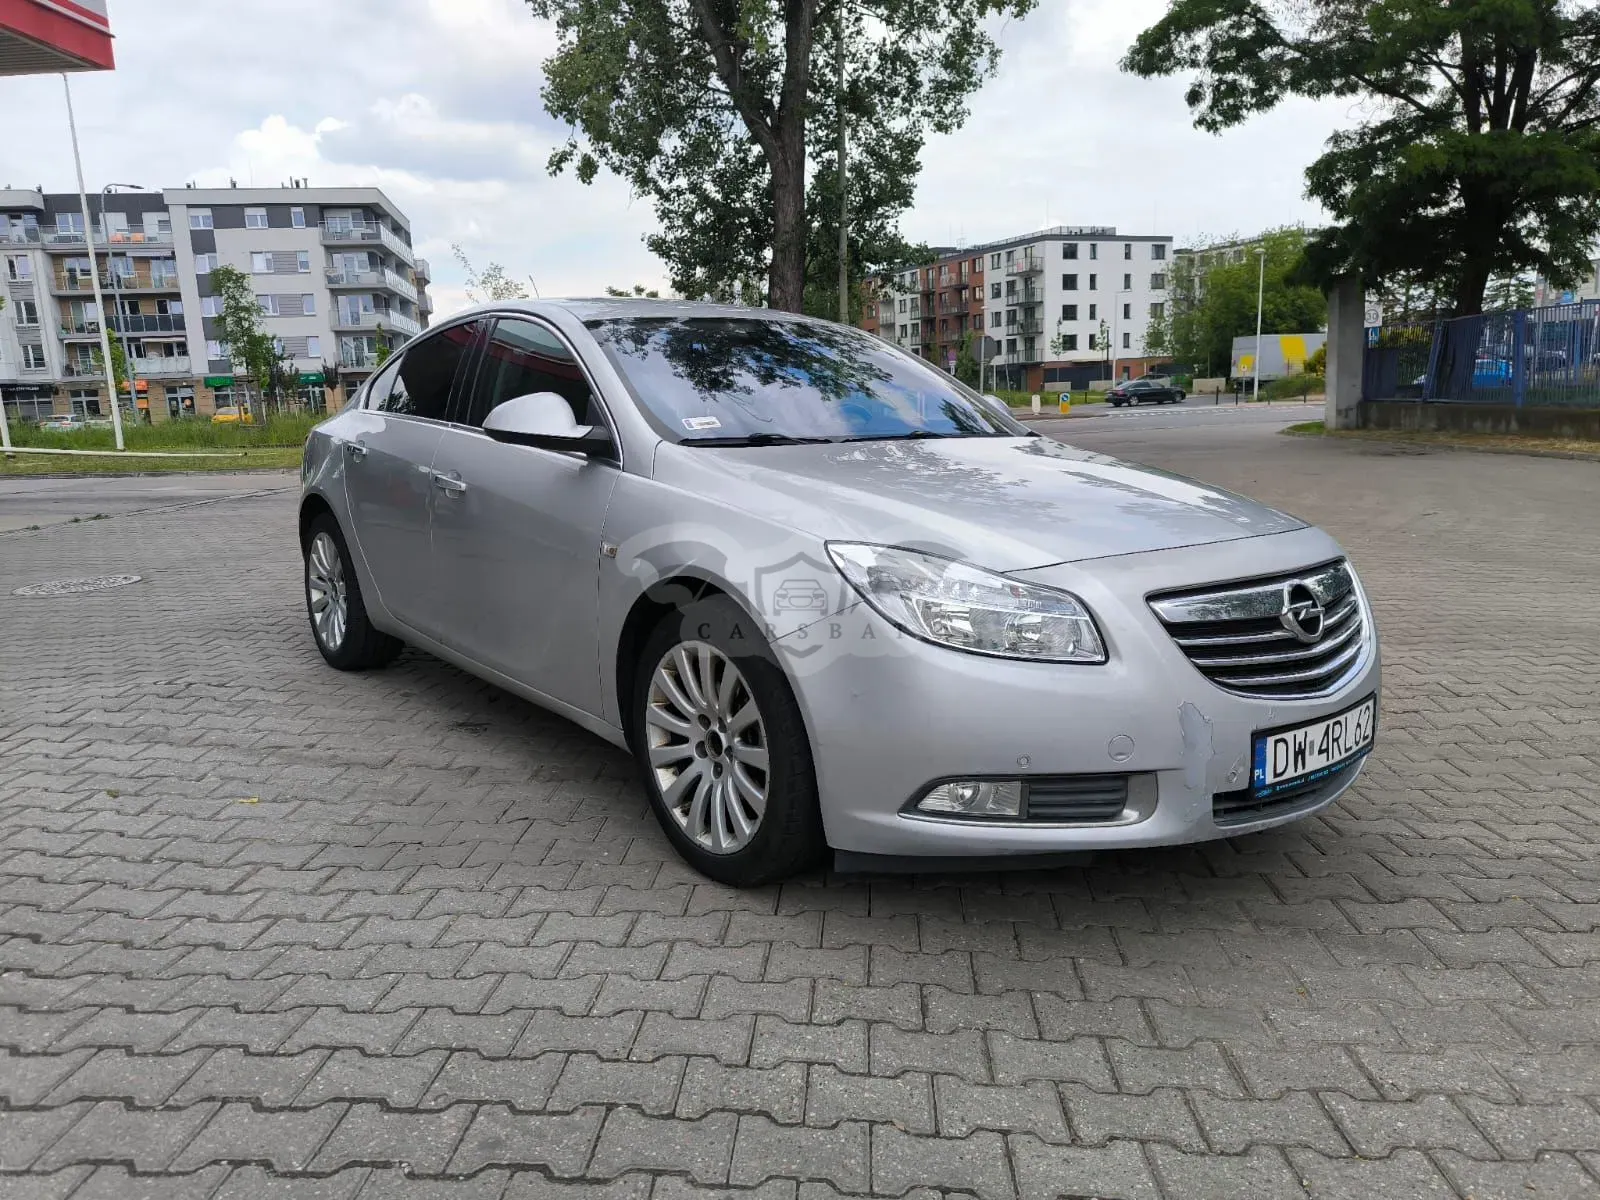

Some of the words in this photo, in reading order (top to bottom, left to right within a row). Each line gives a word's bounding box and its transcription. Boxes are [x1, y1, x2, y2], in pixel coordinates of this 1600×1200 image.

[1273, 731, 1308, 779] DW
[1317, 705, 1371, 762] 4RL62
[1254, 768, 1265, 781] PL
